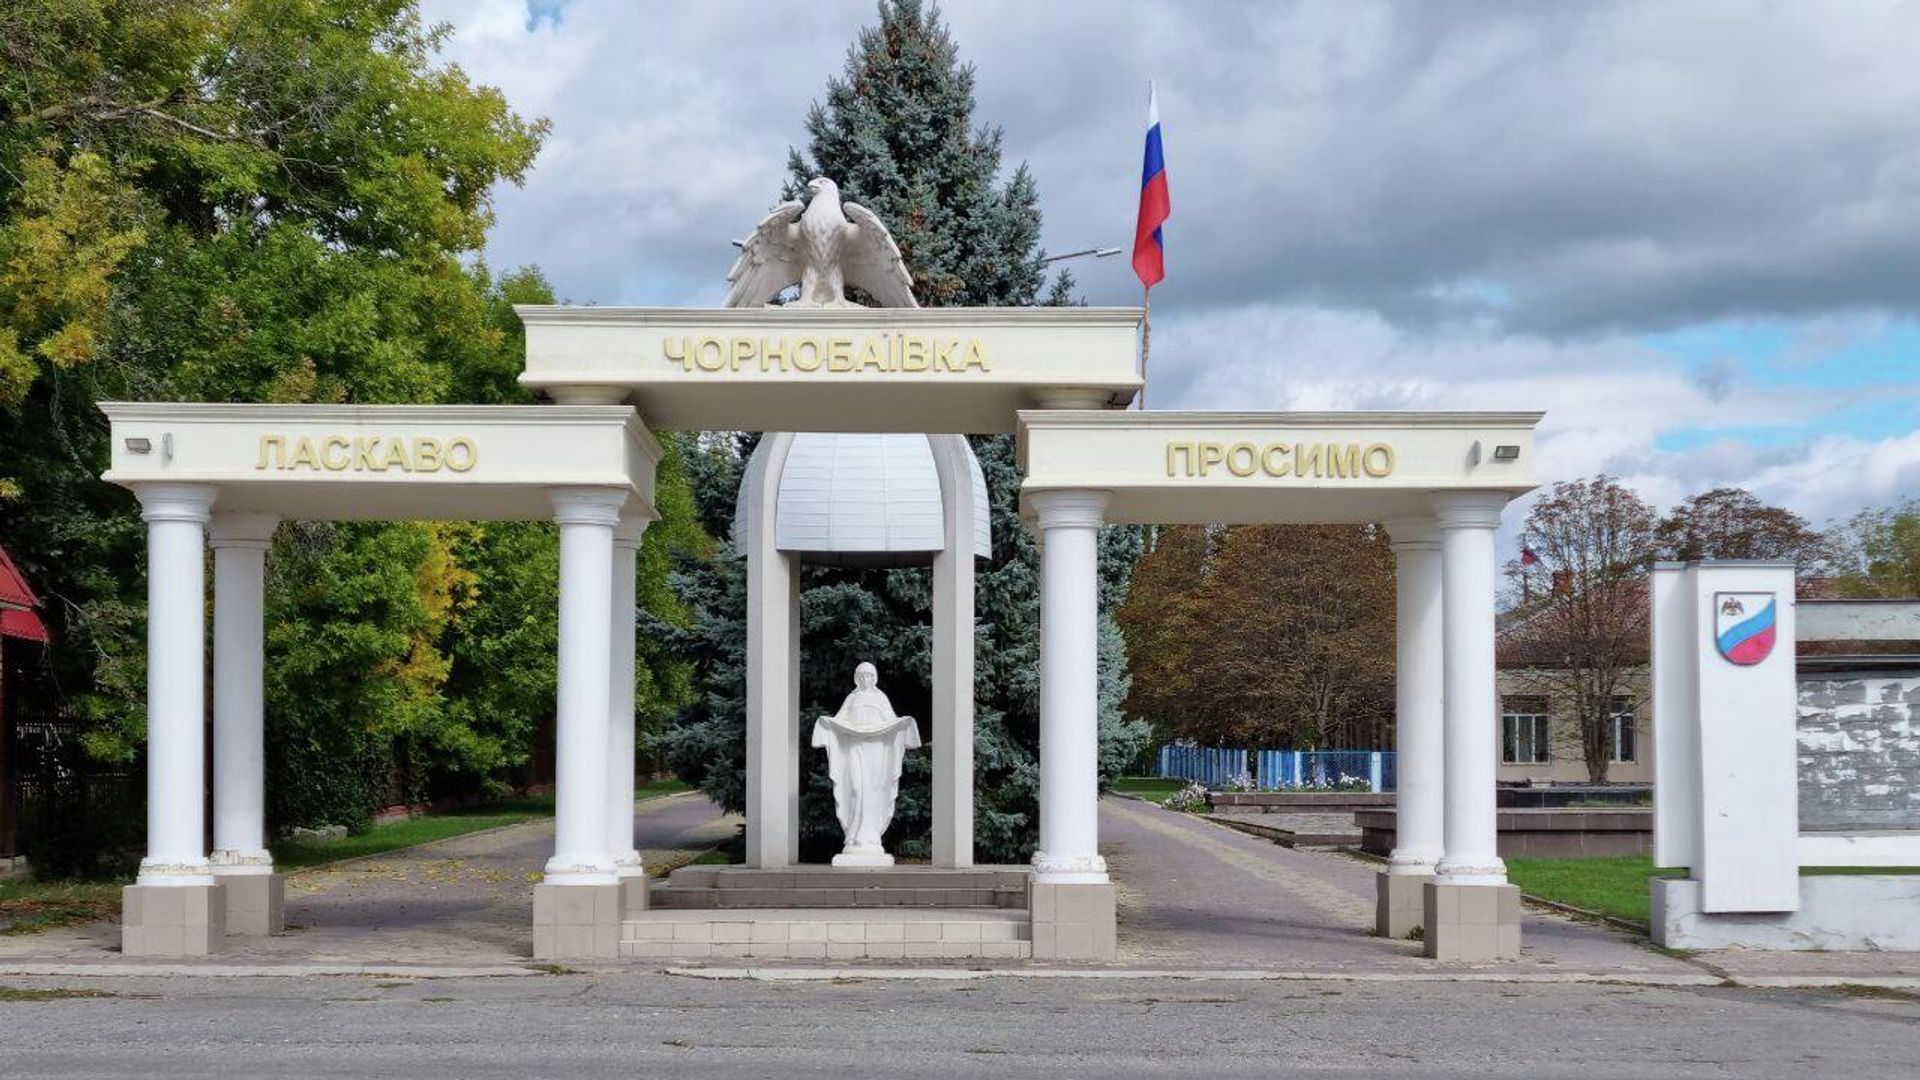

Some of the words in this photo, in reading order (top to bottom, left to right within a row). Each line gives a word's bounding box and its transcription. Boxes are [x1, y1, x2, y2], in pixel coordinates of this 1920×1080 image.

[664, 332, 989, 372] ЧОРНОБАЇВКА
[256, 435, 477, 472] ЛАСКАВО
[1166, 442, 1395, 478] ПРОСИМО
